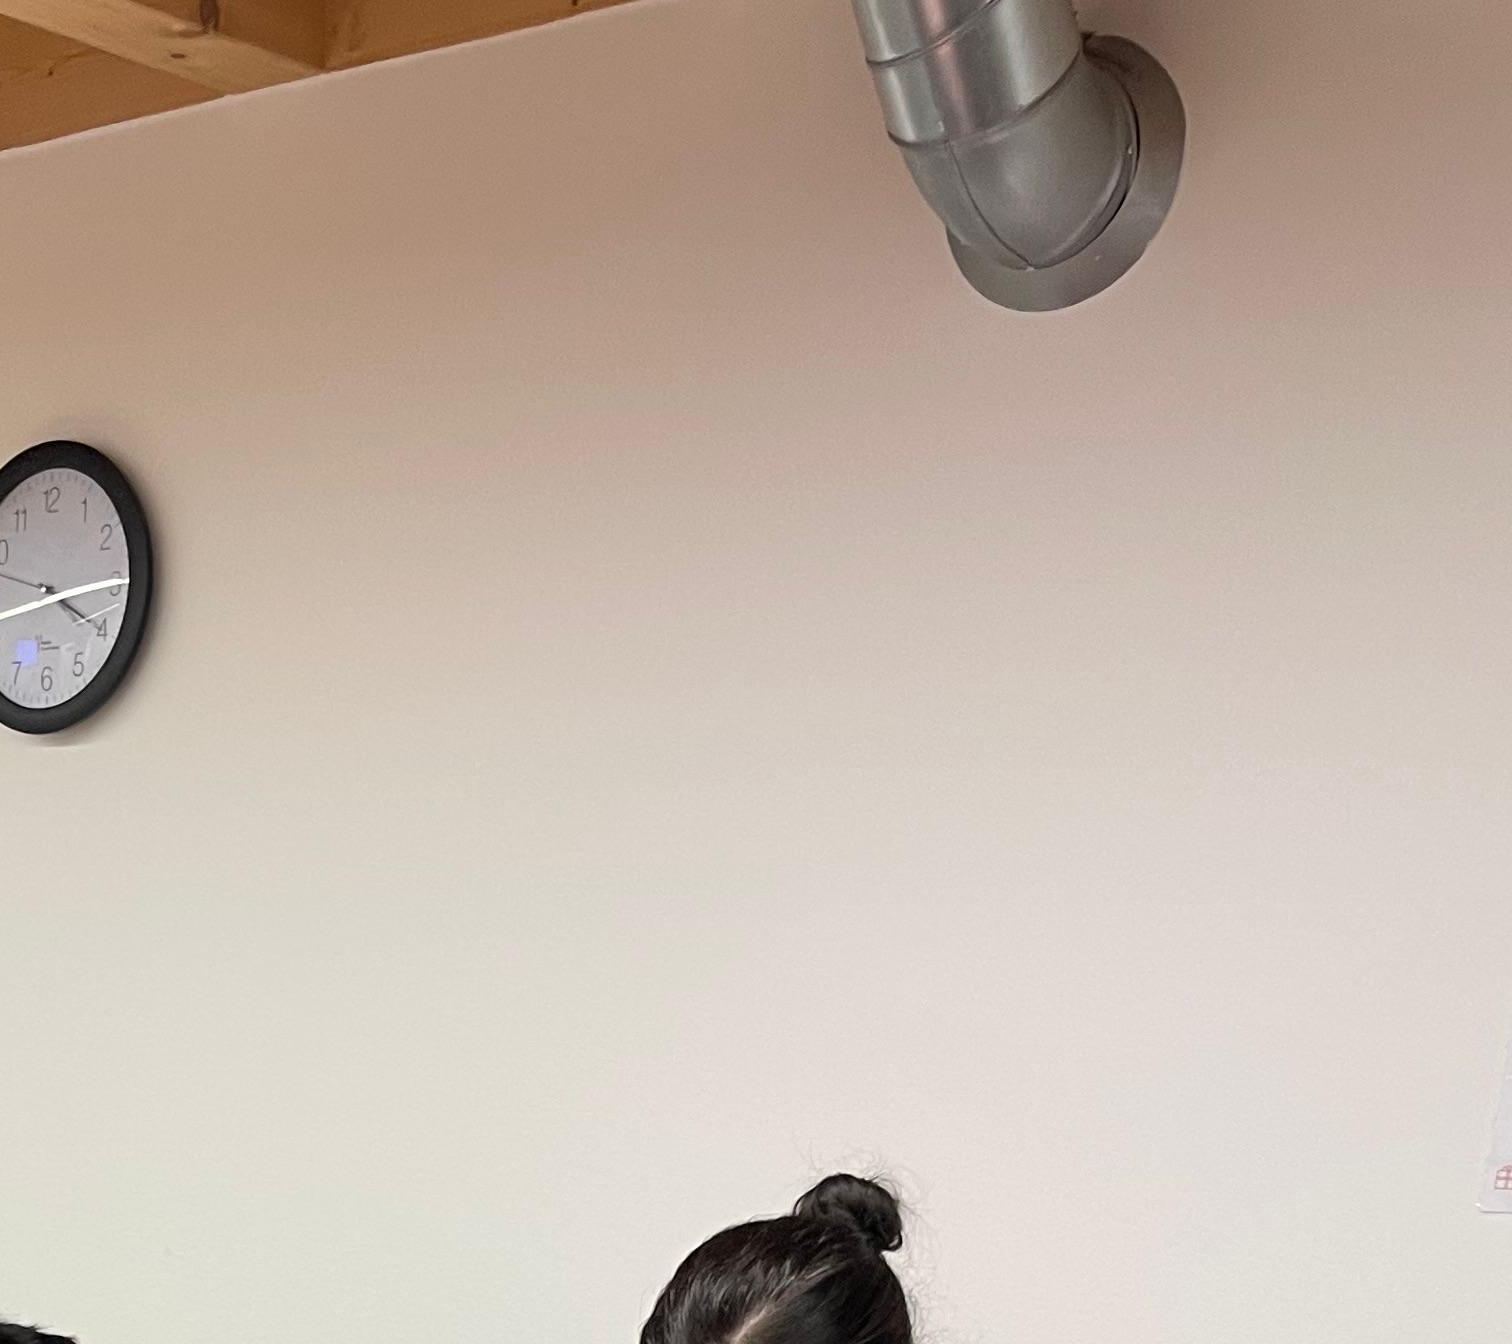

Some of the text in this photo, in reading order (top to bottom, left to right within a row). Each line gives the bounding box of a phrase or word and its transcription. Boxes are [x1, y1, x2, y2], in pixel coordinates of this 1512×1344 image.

[43, 486, 61, 513] 12
[81, 497, 88, 523] 1
[13, 508, 28, 533] 11
[100, 523, 113, 551] 2
[109, 571, 122, 597] 3
[96, 616, 108, 641] 4
[12, 661, 22, 685] 7
[72, 652, 85, 677] 5
[40, 666, 53, 691] 6
